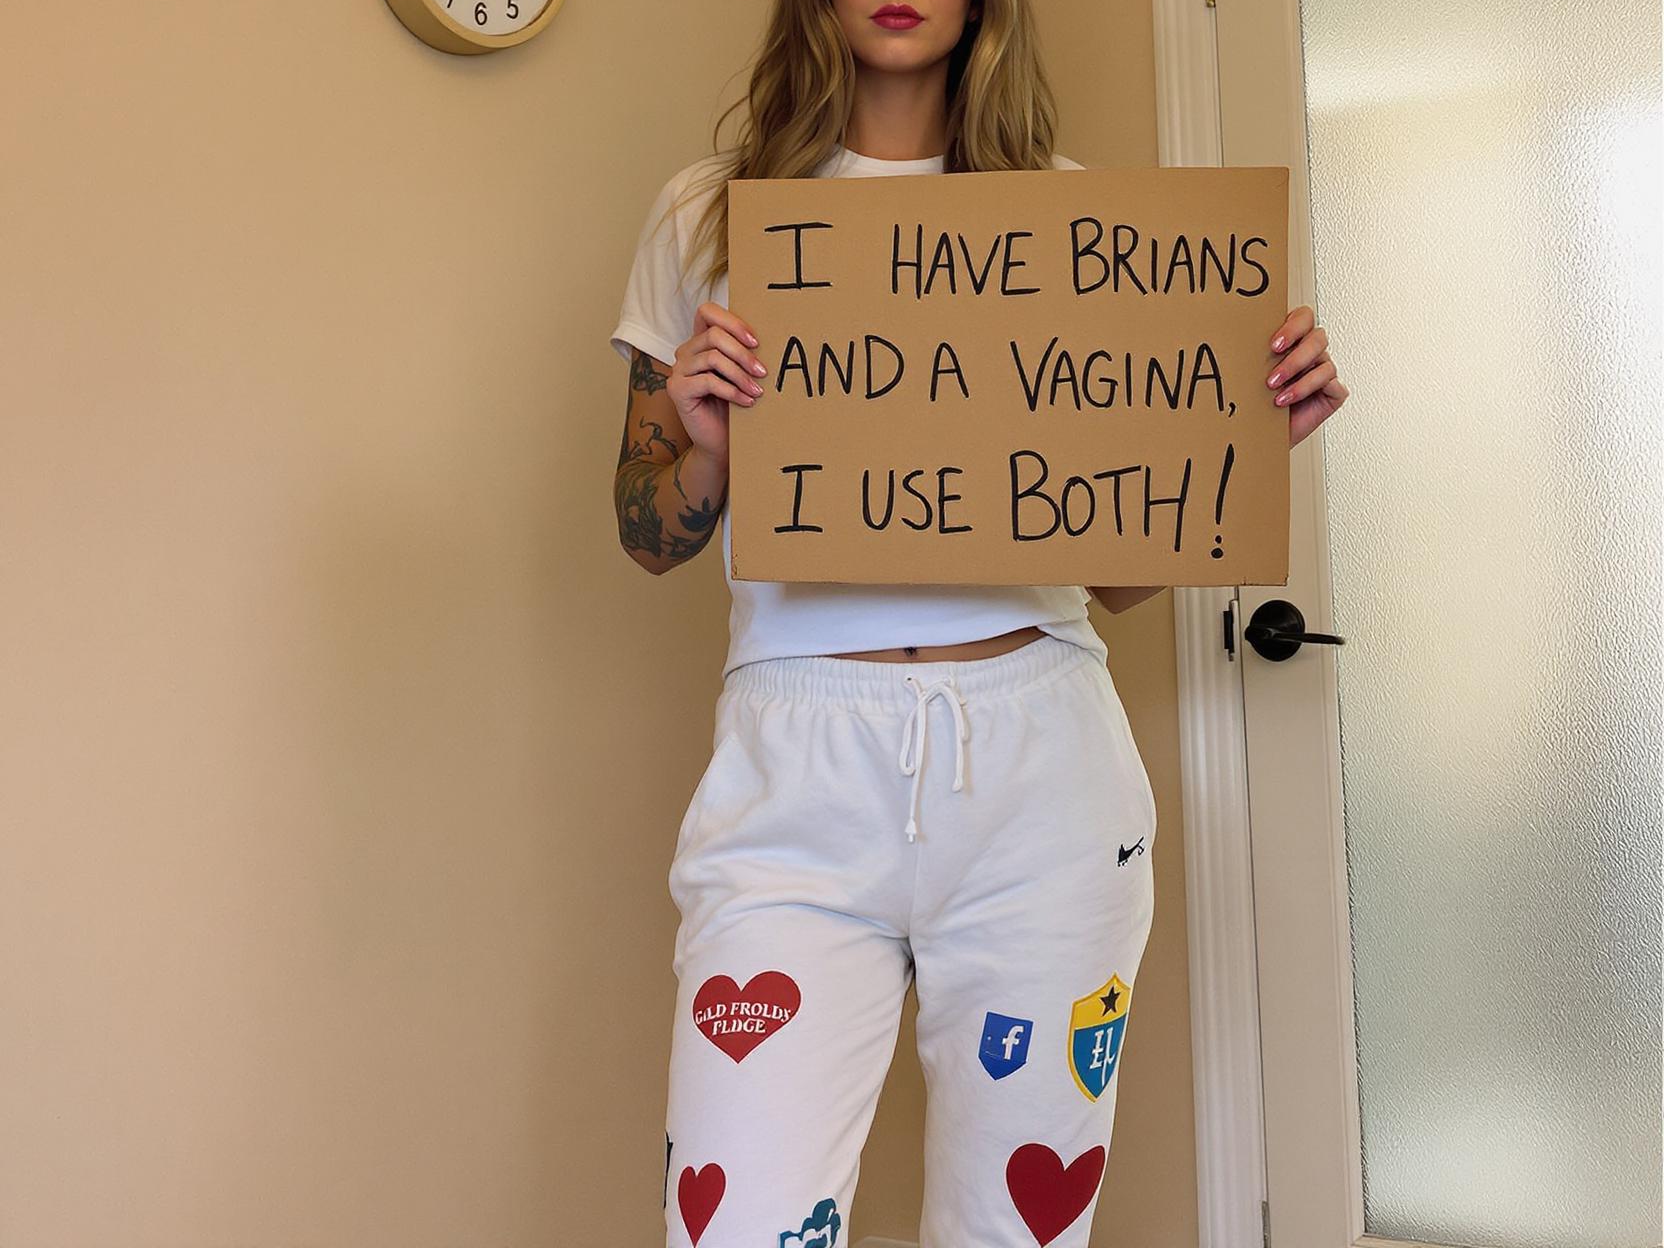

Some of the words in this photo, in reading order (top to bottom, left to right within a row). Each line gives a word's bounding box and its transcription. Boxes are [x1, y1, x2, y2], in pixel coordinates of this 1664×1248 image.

[474, 1, 488, 26] 6
[764, 221, 834, 291] I
[891, 223, 1041, 300] HAVE
[1069, 216, 1270, 298] BRIANS
[775, 334, 905, 400] AND
[929, 342, 970, 402] A
[1009, 336, 1238, 419] VAGINA,
[774, 464, 823, 535] I
[862, 467, 973, 535] USE
